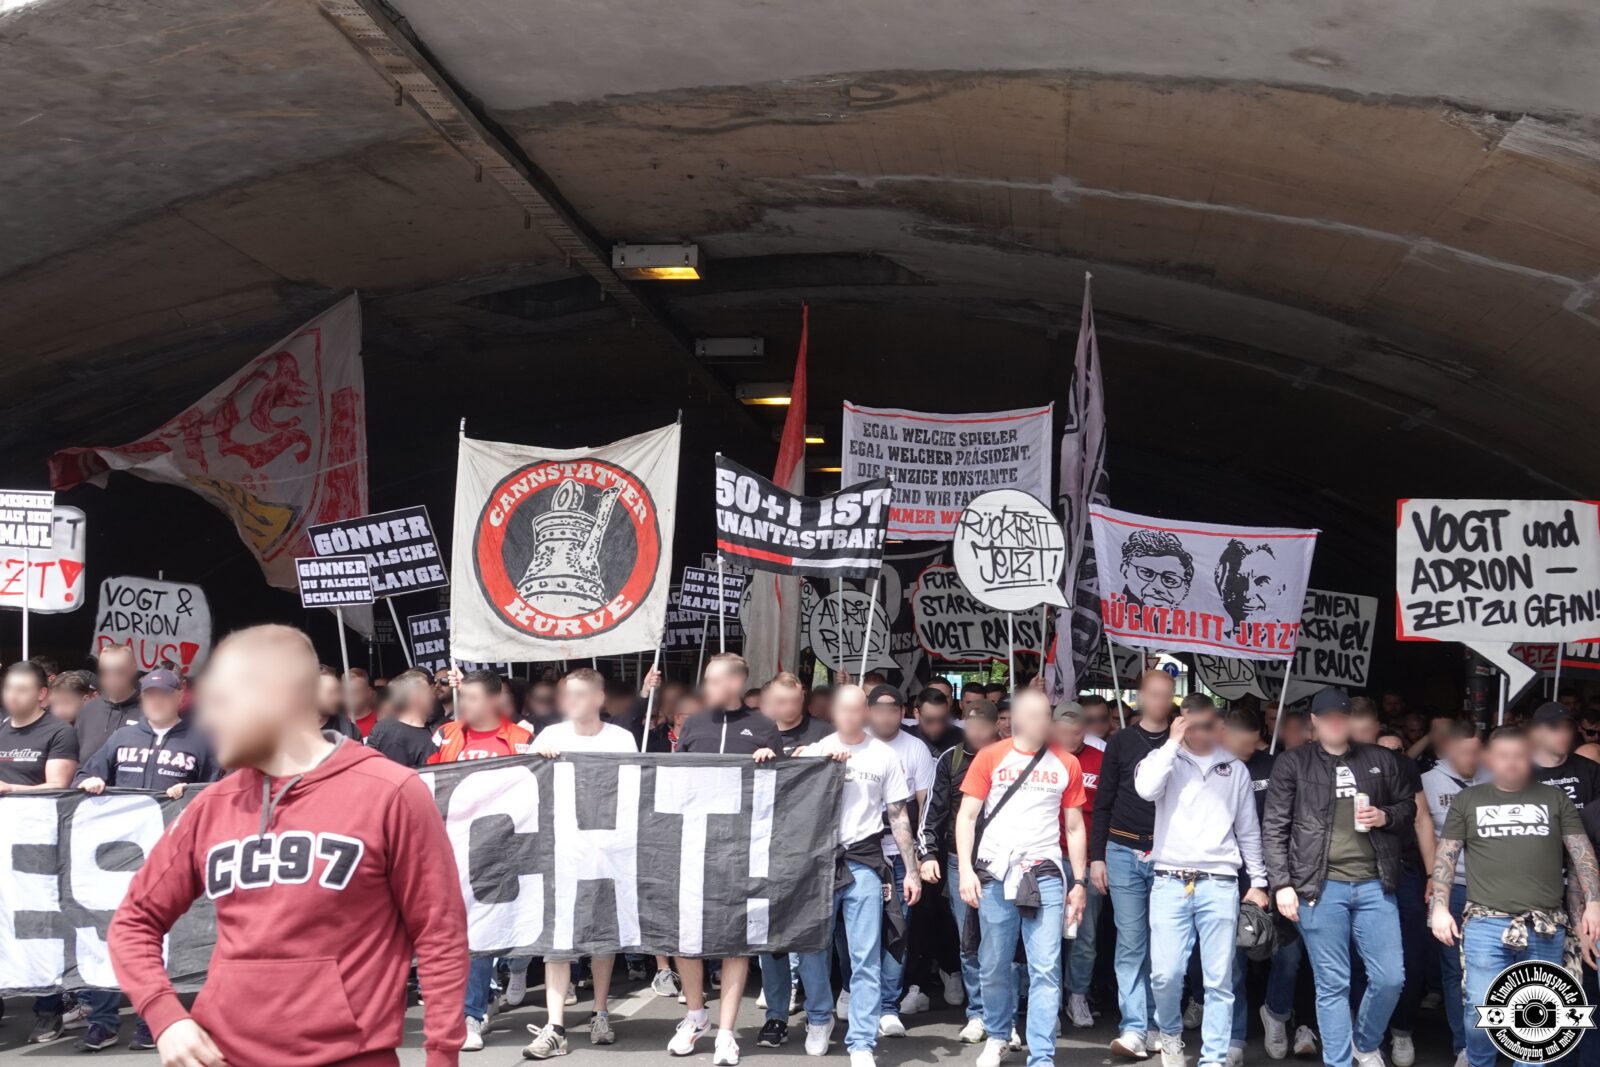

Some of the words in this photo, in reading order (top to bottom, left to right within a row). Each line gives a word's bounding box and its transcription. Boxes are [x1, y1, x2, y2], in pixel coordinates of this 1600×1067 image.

[863, 422, 898, 440] EGAL
[902, 427, 956, 446] WELCHE
[959, 429, 1018, 447] SPIELER
[849, 439, 884, 459] EGAL
[888, 446, 952, 465] WELCHER
[858, 462, 880, 478] DIE
[884, 466, 938, 484] EINZIGE
[942, 468, 1018, 486] KONSTANTE
[489, 463, 648, 527] CANNSTATTER
[817, 488, 892, 526] IST
[925, 490, 951, 506] WIR
[889, 507, 936, 524] MMER
[314, 515, 430, 556] GÖNNER
[1411, 505, 1511, 553] VOGT
[1522, 509, 1580, 549] und
[367, 542, 437, 568] ALSCHE
[300, 561, 367, 577] GÖNNER
[371, 564, 444, 592] LANGE
[686, 571, 705, 582] IHR
[922, 571, 961, 590] FÜR
[1410, 553, 1534, 595] ADRION
[302, 579, 318, 590] DU
[320, 577, 370, 589] FALSCHE
[684, 583, 705, 594] DEN
[105, 582, 168, 611] VOGT
[176, 587, 194, 617] &
[304, 590, 372, 604] SCHLANGE
[412, 618, 441, 636] IHR
[504, 594, 633, 636] KURVE
[414, 638, 445, 656] DEN
[920, 620, 975, 651] VOGT
[1314, 648, 1365, 683] RAUS
[116, 747, 196, 771] ULTRAS
[1477, 825, 1550, 838] ULTRAS
[206, 830, 364, 899] CC97
